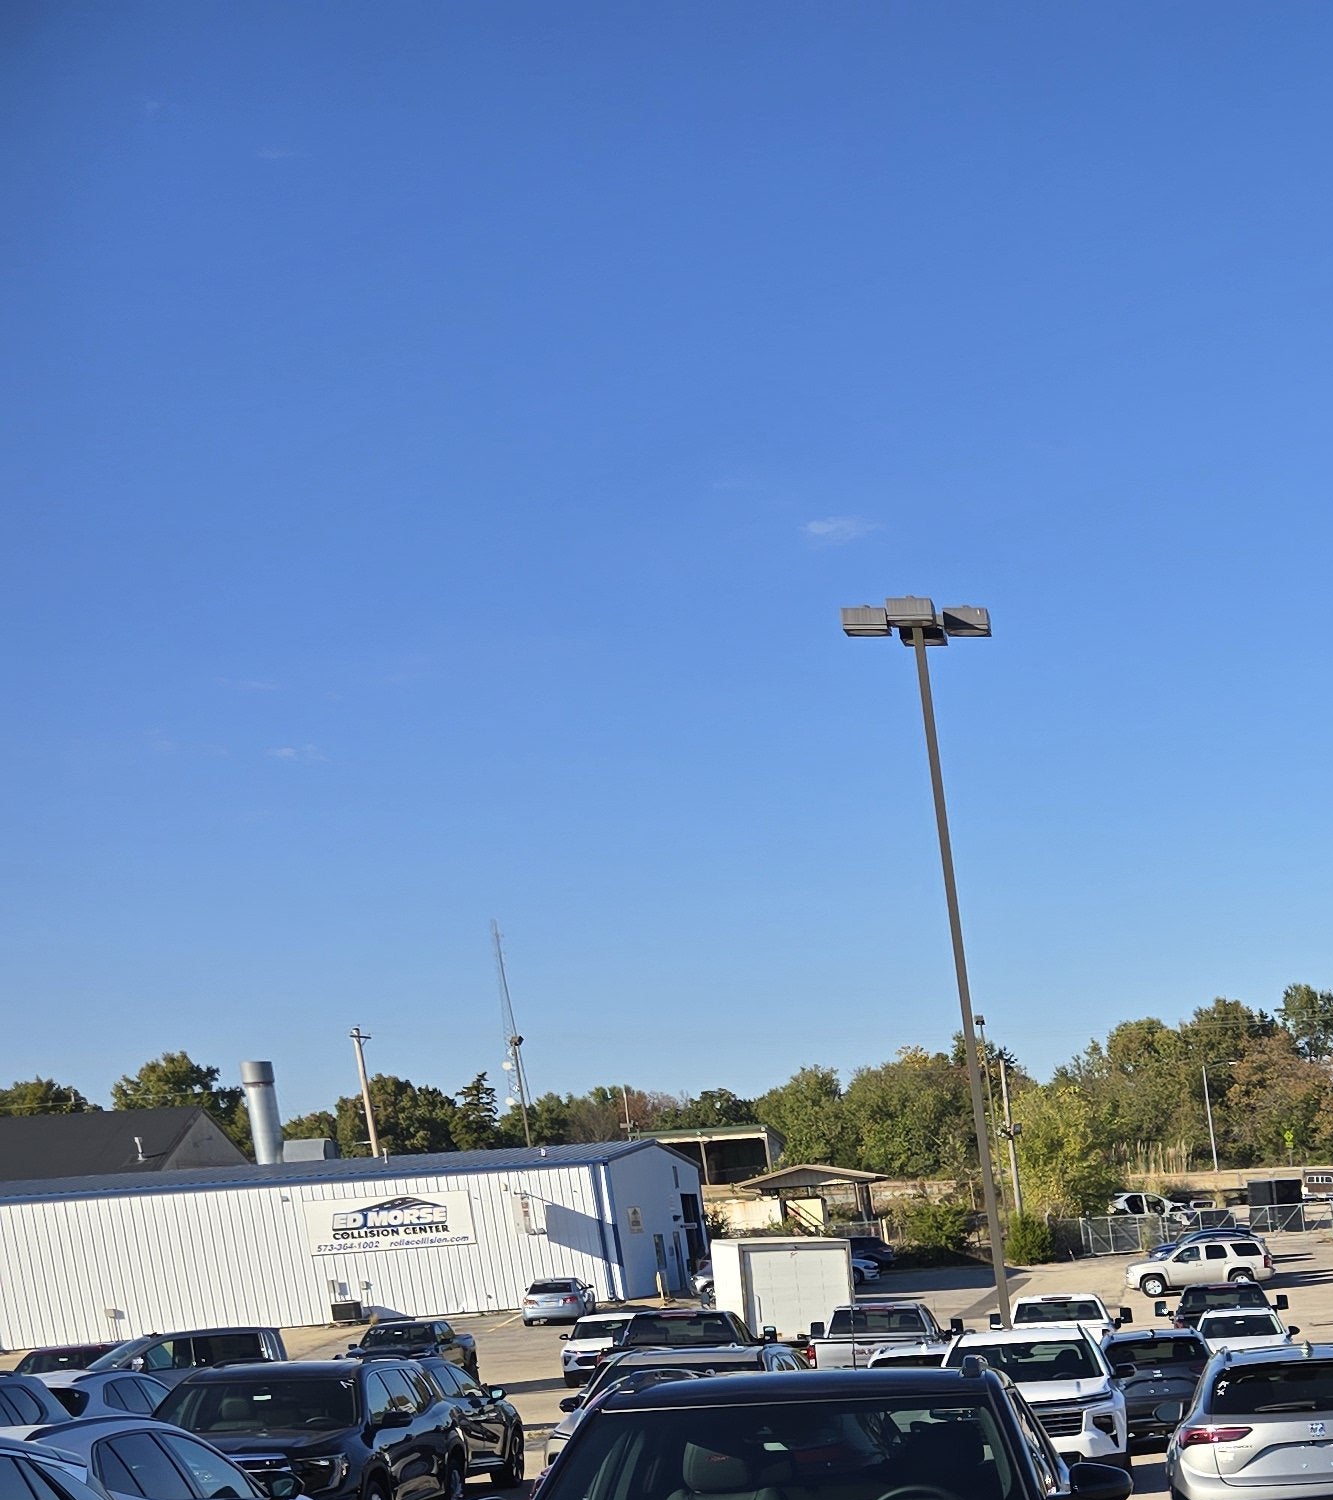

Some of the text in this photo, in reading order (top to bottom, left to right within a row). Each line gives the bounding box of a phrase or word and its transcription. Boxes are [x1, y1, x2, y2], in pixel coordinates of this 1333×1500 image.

[332, 1205, 448, 1231] ED MORSE
[333, 1224, 450, 1241] COLLISION CENTER
[317, 1240, 380, 1252] 573-364-1002
